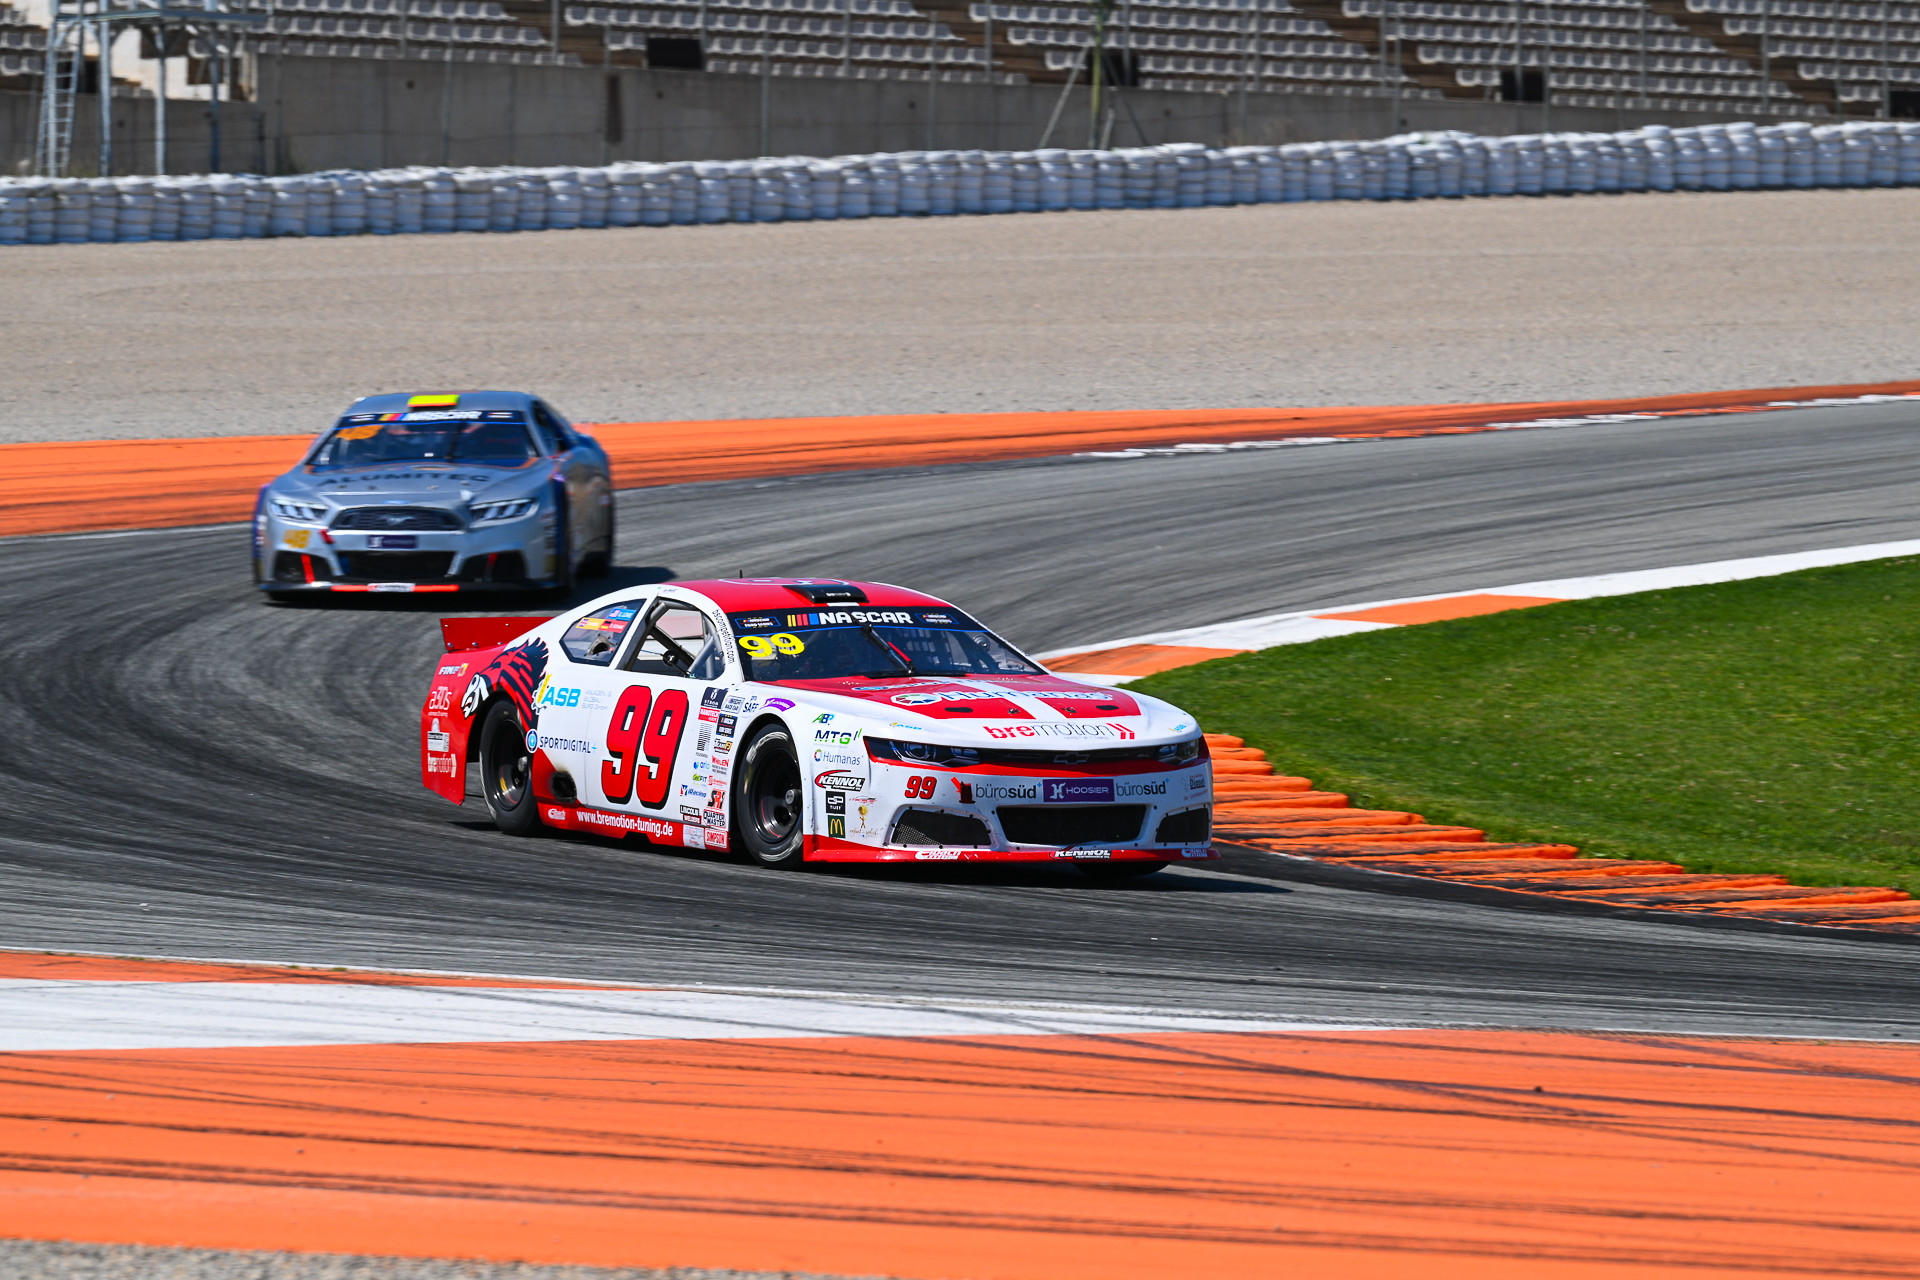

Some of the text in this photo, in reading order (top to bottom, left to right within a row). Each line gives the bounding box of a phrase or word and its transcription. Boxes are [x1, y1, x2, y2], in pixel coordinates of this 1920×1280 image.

[316, 473, 491, 486] ALUMITEC
[819, 611, 914, 625] NASCAR
[739, 633, 805, 658] 99
[541, 686, 581, 707] ASB
[814, 729, 852, 745] MTG
[983, 722, 1113, 739] bremotion
[602, 685, 689, 810] 99
[823, 751, 861, 765] Humanas
[818, 775, 864, 788] KENNOL
[904, 775, 937, 800] 99
[1116, 780, 1166, 797] bürosüd
[975, 783, 1037, 799] bürosüd
[576, 810, 673, 837] www.bremotion-tuning.de
[707, 832, 725, 844] SIMPSON
